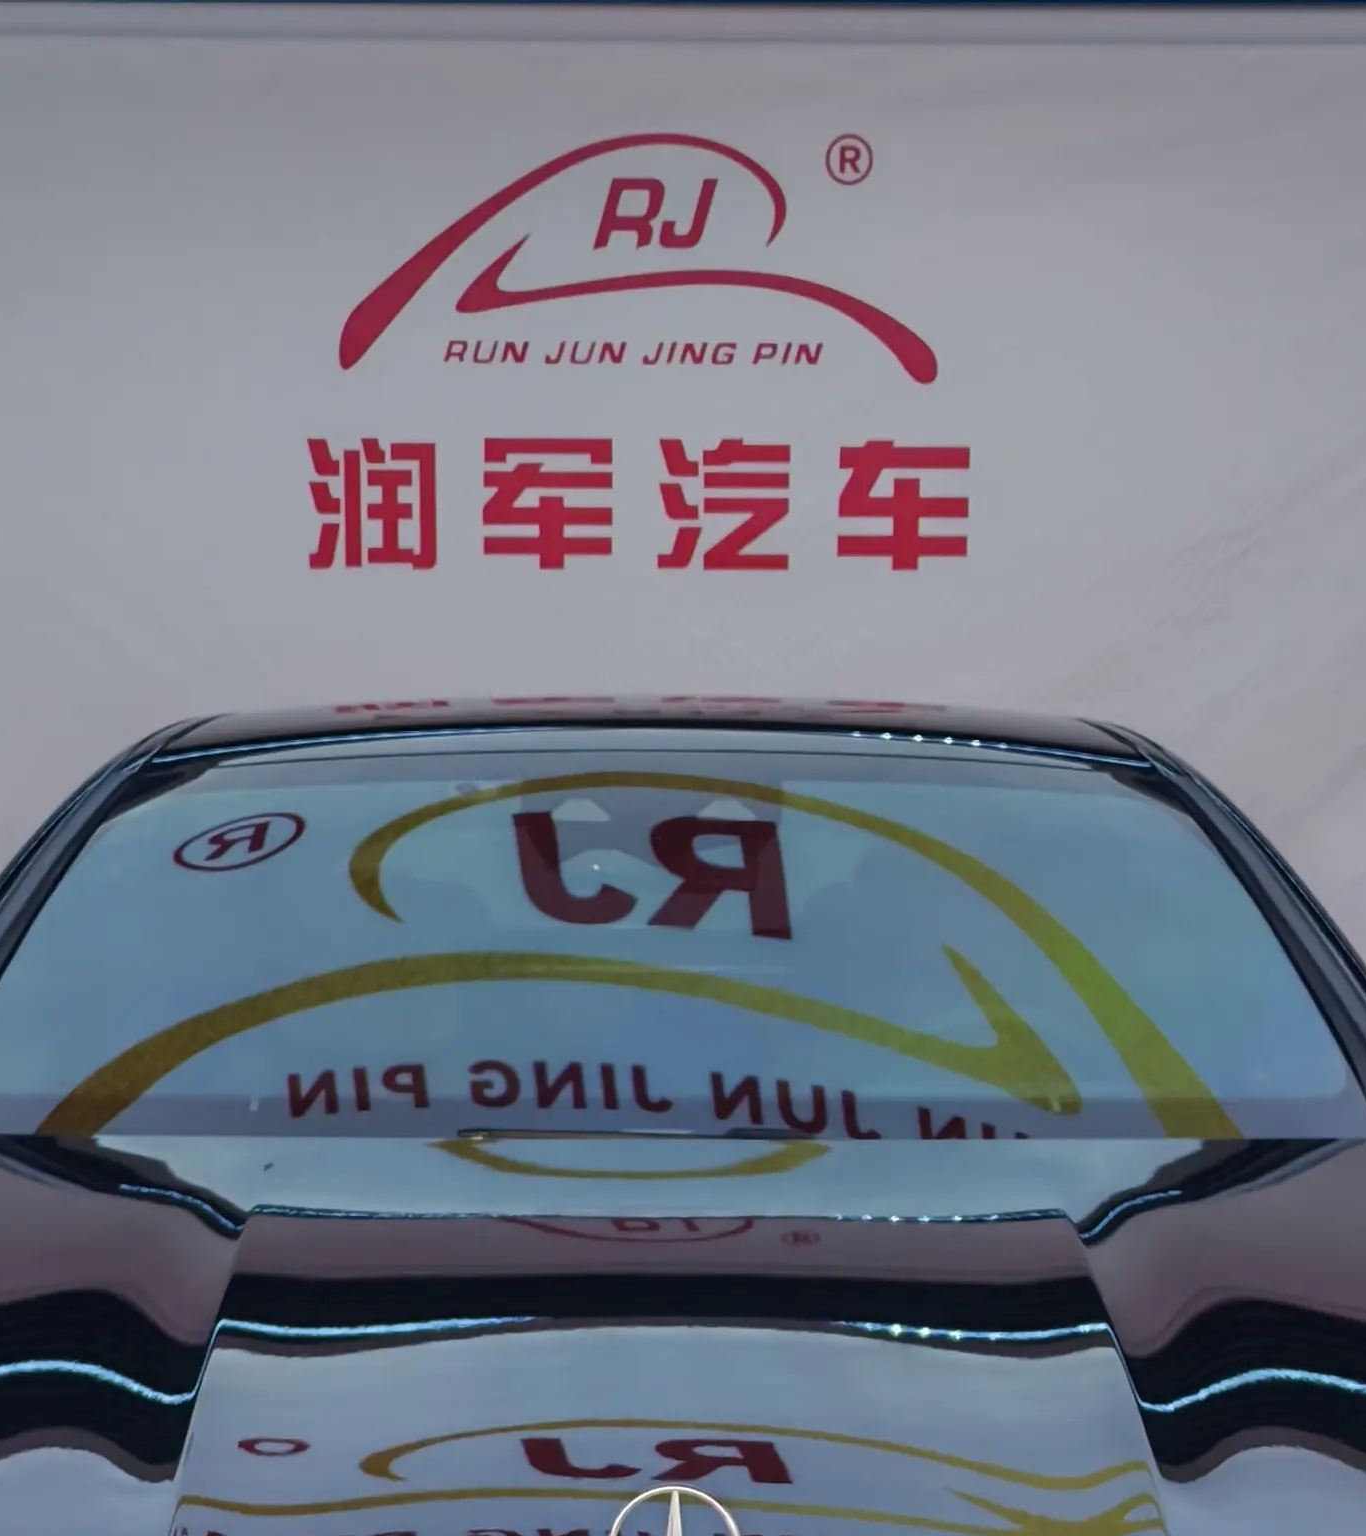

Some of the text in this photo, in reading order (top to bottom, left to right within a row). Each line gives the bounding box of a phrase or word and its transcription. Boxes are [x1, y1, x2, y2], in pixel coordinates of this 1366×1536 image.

[592, 177, 718, 250] RJ
[443, 340, 825, 366] RUN JUN JING PIN
[306, 437, 972, 572] 润军汽车
